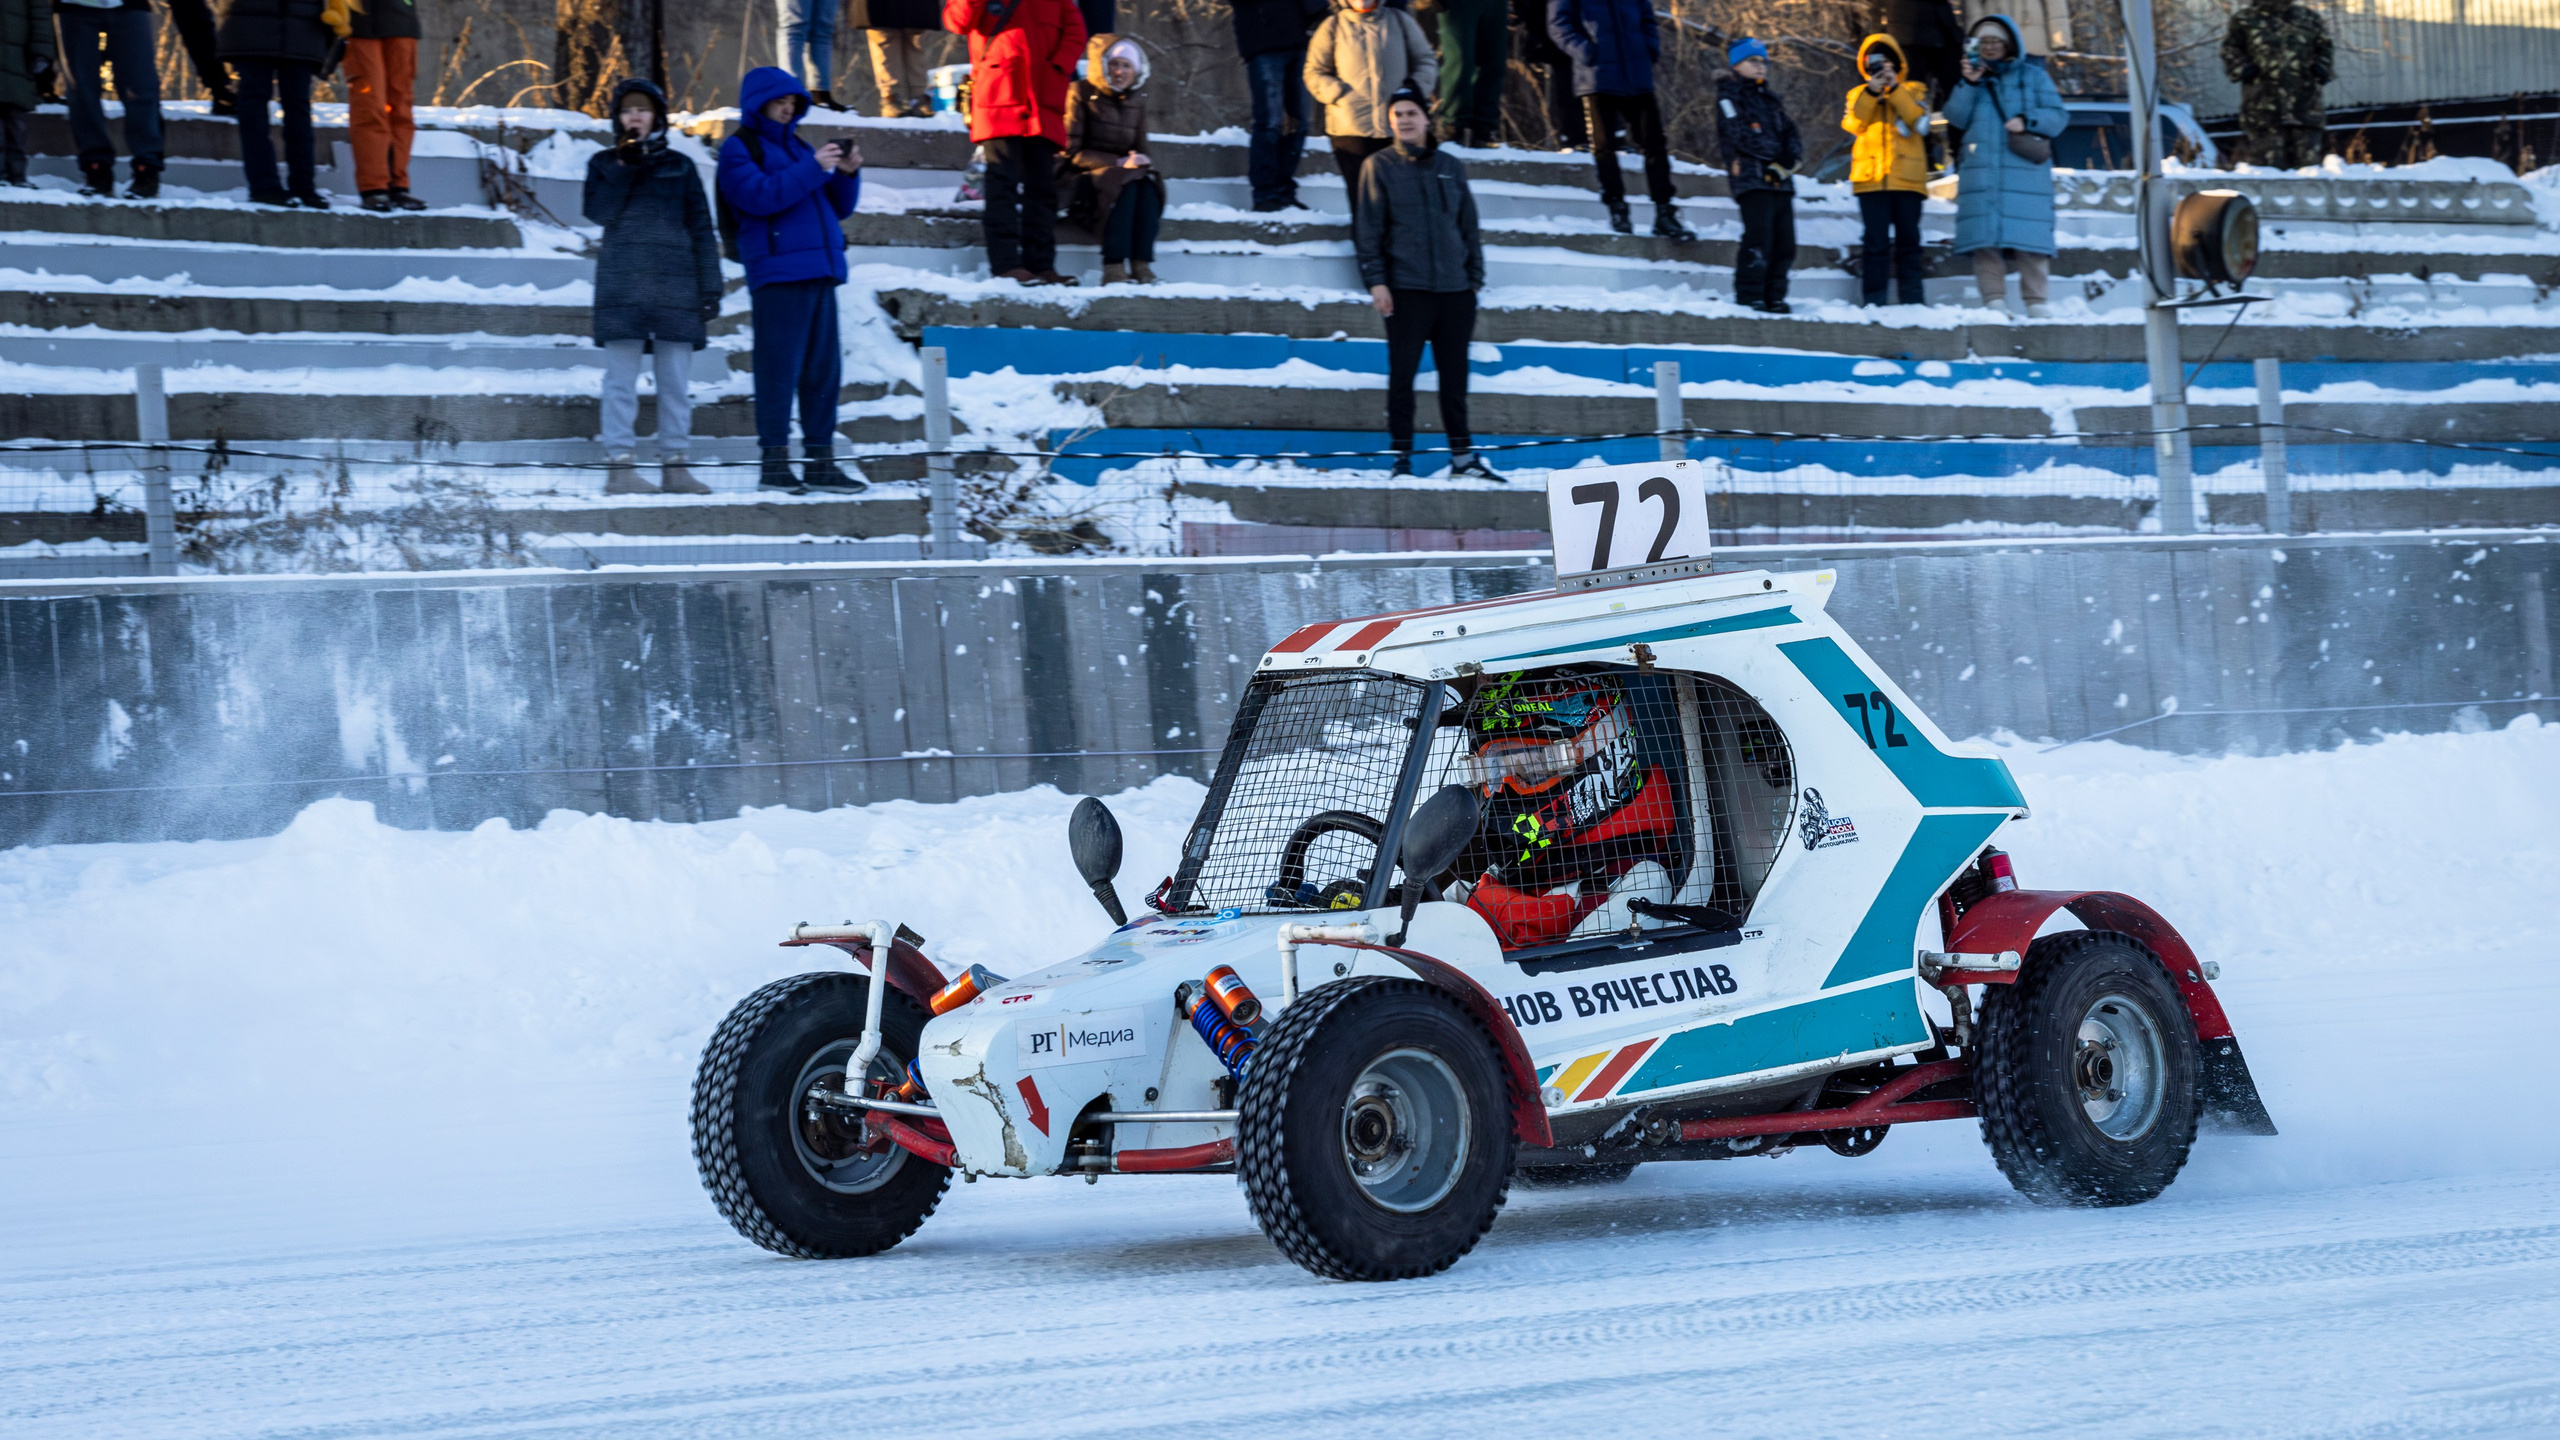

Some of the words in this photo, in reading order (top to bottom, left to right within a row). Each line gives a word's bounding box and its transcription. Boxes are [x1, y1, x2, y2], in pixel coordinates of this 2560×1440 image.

[1571, 477, 1689, 571] 72
[1843, 691, 1909, 749] 72
[1828, 818, 1851, 827] LIQUI
[1830, 825, 1853, 834] MOLY
[1818, 837, 1860, 849] МОТОЦИКЛИСТ
[1567, 964, 1738, 1018] ВЯЧЕСЛАВ
[1031, 1032, 1057, 1054] РГ
[1069, 1028, 1134, 1048] Медиа
